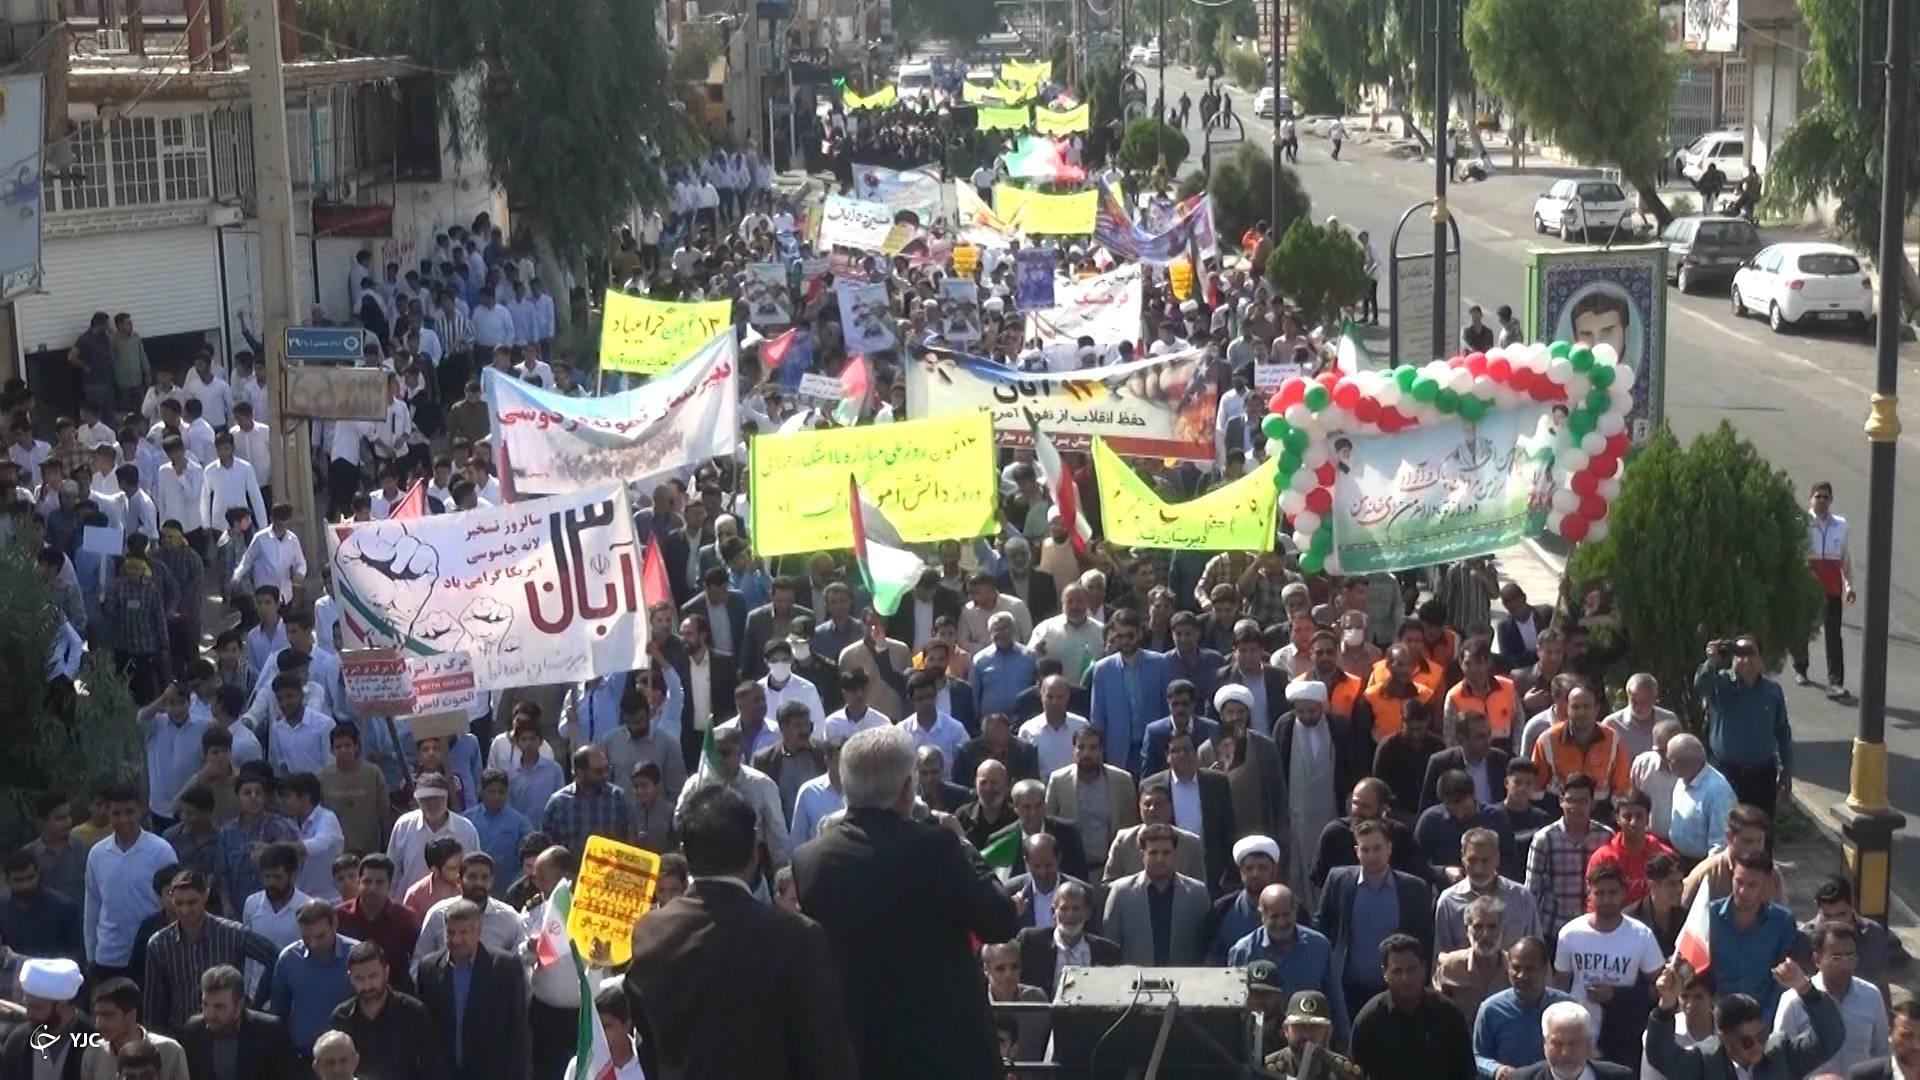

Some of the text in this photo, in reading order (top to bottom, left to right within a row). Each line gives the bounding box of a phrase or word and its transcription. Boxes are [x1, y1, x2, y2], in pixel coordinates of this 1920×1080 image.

[1031, 410, 1055, 423] نفو
[1071, 408, 1114, 426] انقلاب
[1117, 409, 1146, 427] حفظ
[465, 512, 542, 542] سالروز تسخیر
[466, 536, 540, 565] لانه جاسوسی
[443, 558, 543, 590] آمریکا گرامی باد
[1574, 952, 1632, 975] REPLAY
